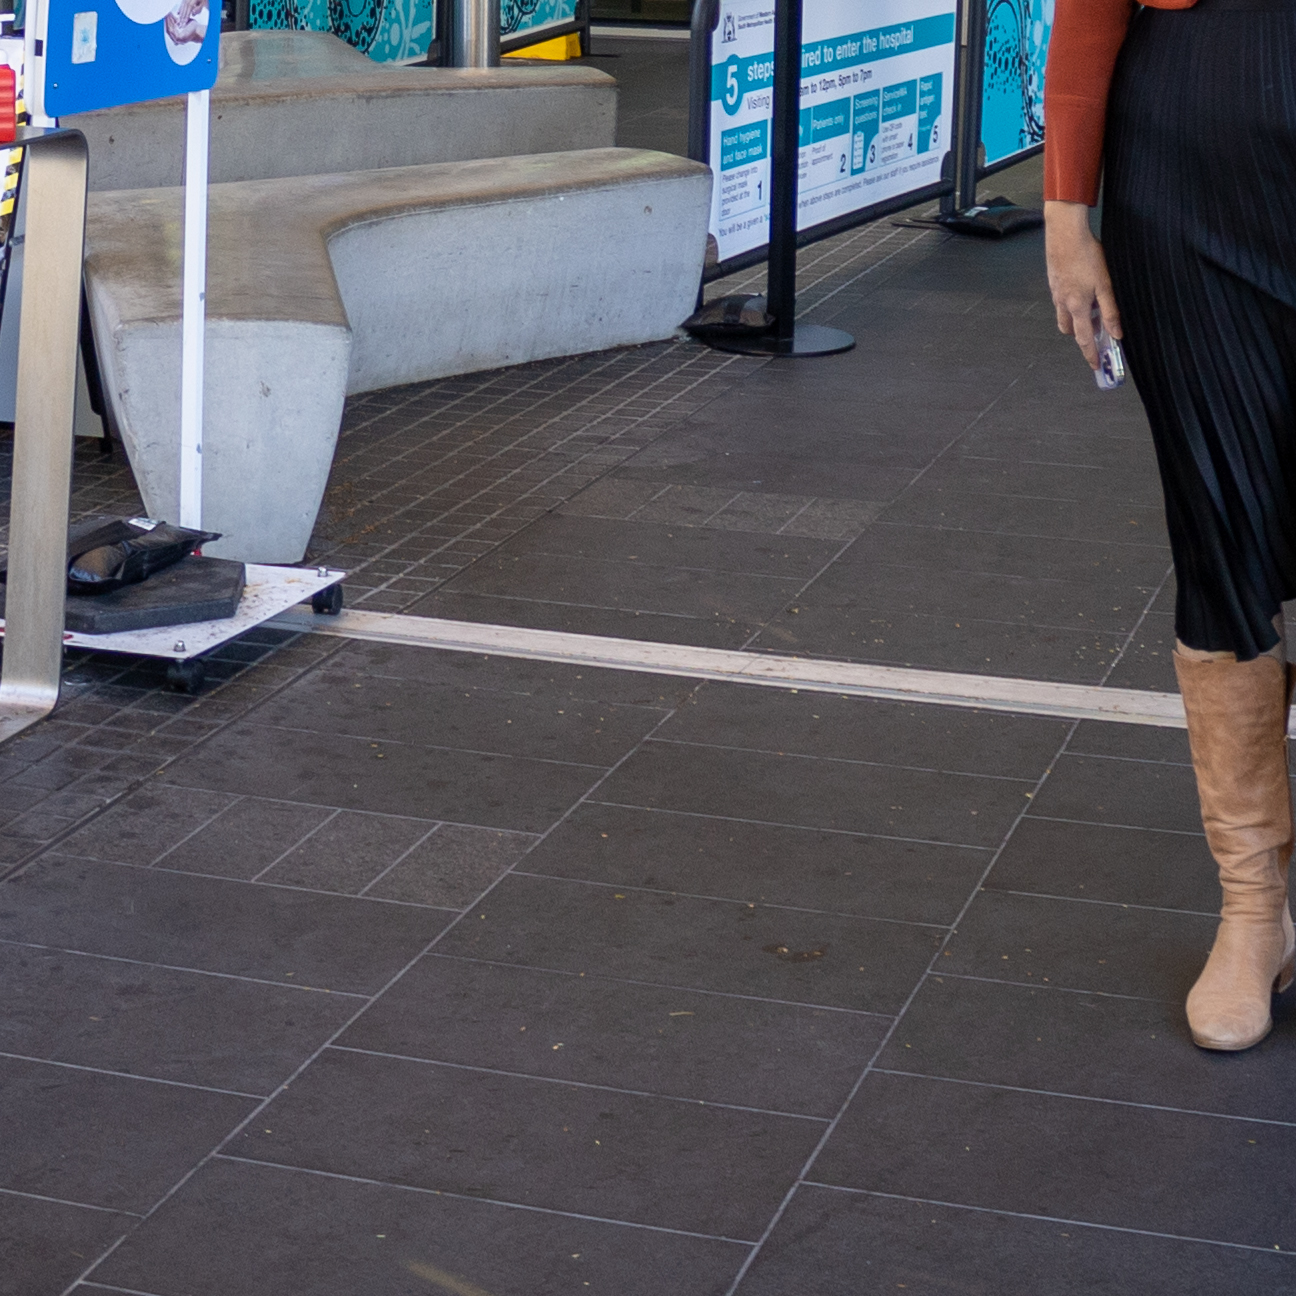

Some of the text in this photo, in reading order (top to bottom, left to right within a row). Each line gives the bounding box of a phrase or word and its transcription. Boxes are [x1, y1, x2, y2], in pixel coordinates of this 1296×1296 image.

[726, 65, 738, 105] 5
[824, 45, 833, 63] to
[836, 39, 861, 60] enter
[863, 33, 877, 53] the
[879, 25, 914, 50] hospital
[747, 69, 872, 109] Visiting to 5pm to 7pm
[908, 133, 913, 150] 4
[933, 125, 938, 143] 5
[840, 154, 846, 173] 2
[870, 145, 876, 163] 3
[758, 180, 762, 201] 1
